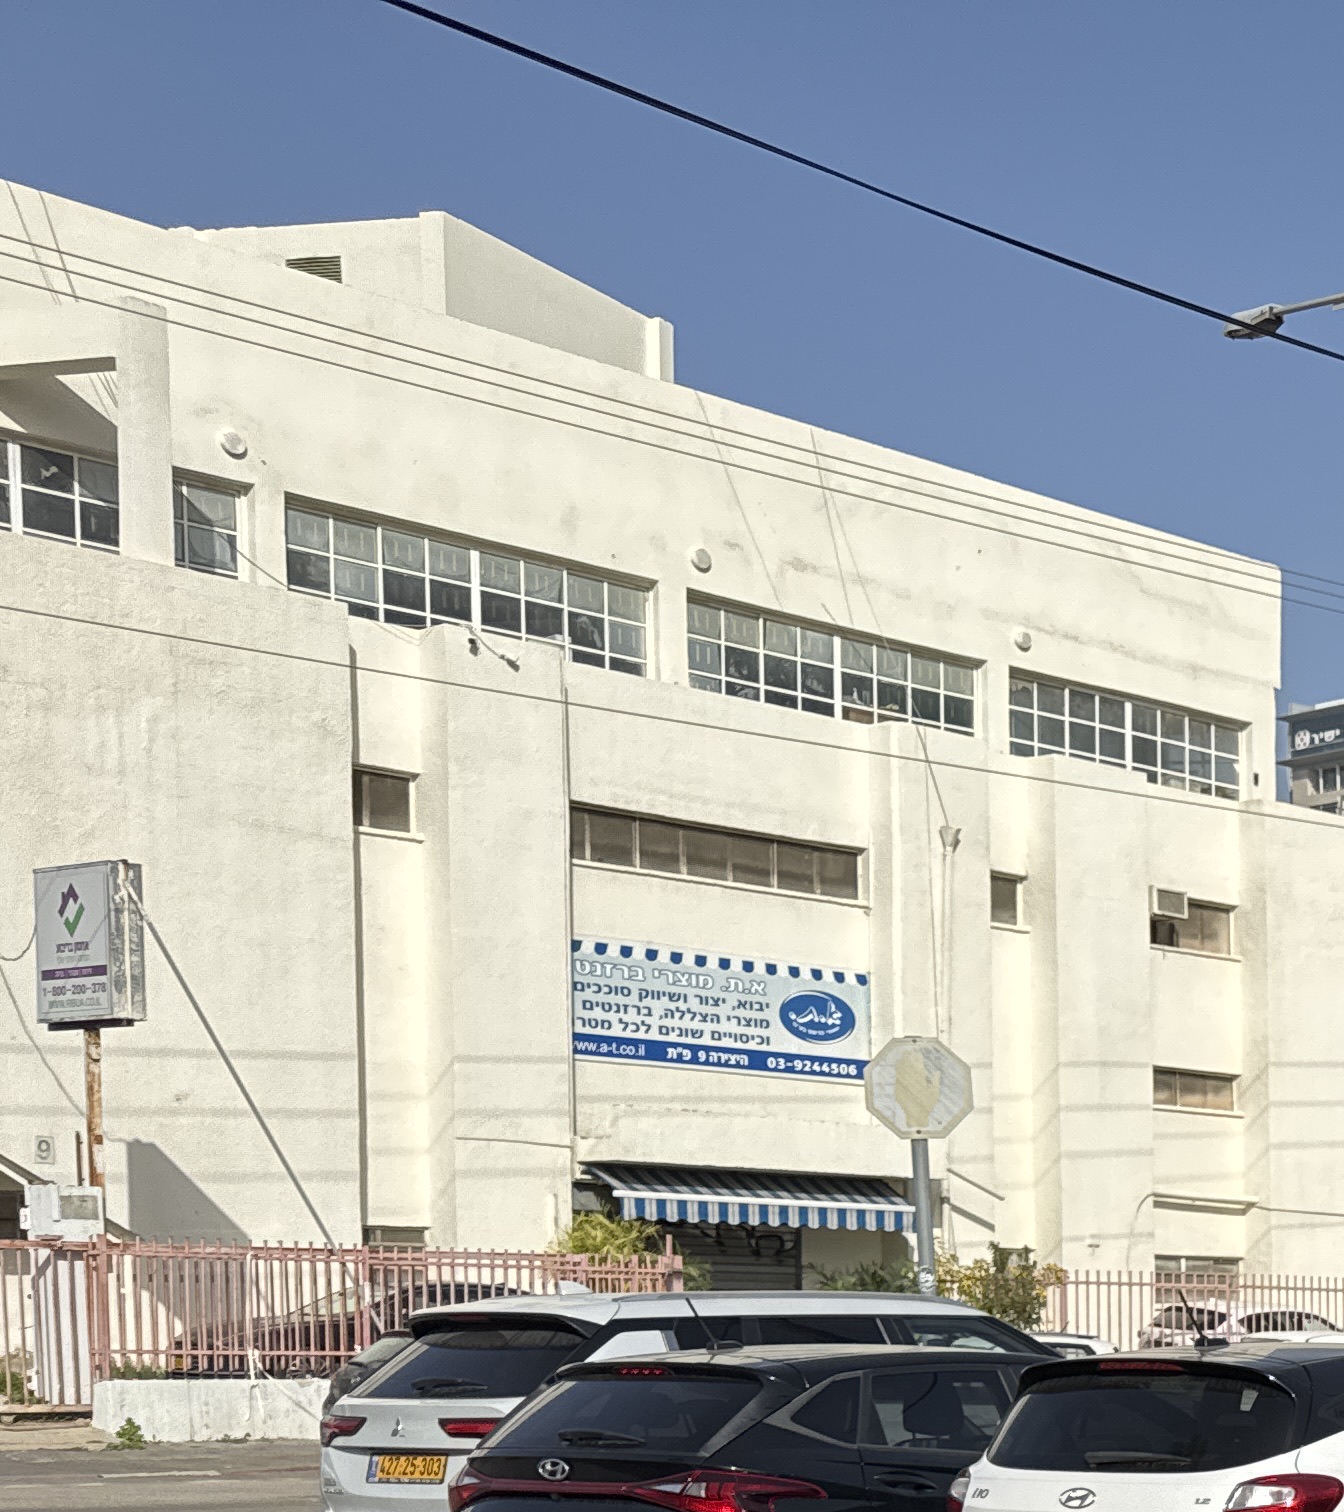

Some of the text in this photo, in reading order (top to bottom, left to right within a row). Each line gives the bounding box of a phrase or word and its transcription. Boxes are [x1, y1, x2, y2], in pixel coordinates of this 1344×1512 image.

[1311, 729, 1340, 745] ישיר
[574, 959, 646, 982] ברזנט
[652, 968, 715, 990] מוצרי
[573, 981, 770, 1012] יבוא, יצור ושיווק סוככים
[582, 999, 770, 1029] מוצרי הצללה, ברזנטים
[618, 1018, 652, 1034] לכל
[658, 1025, 704, 1040] שונים
[711, 1030, 771, 1046] וכיסויים
[698, 1050, 706, 1062] 9
[709, 1052, 749, 1066] היצירה
[766, 1057, 858, 1076] 03-9244506
[37, 1139, 51, 1160] 9
